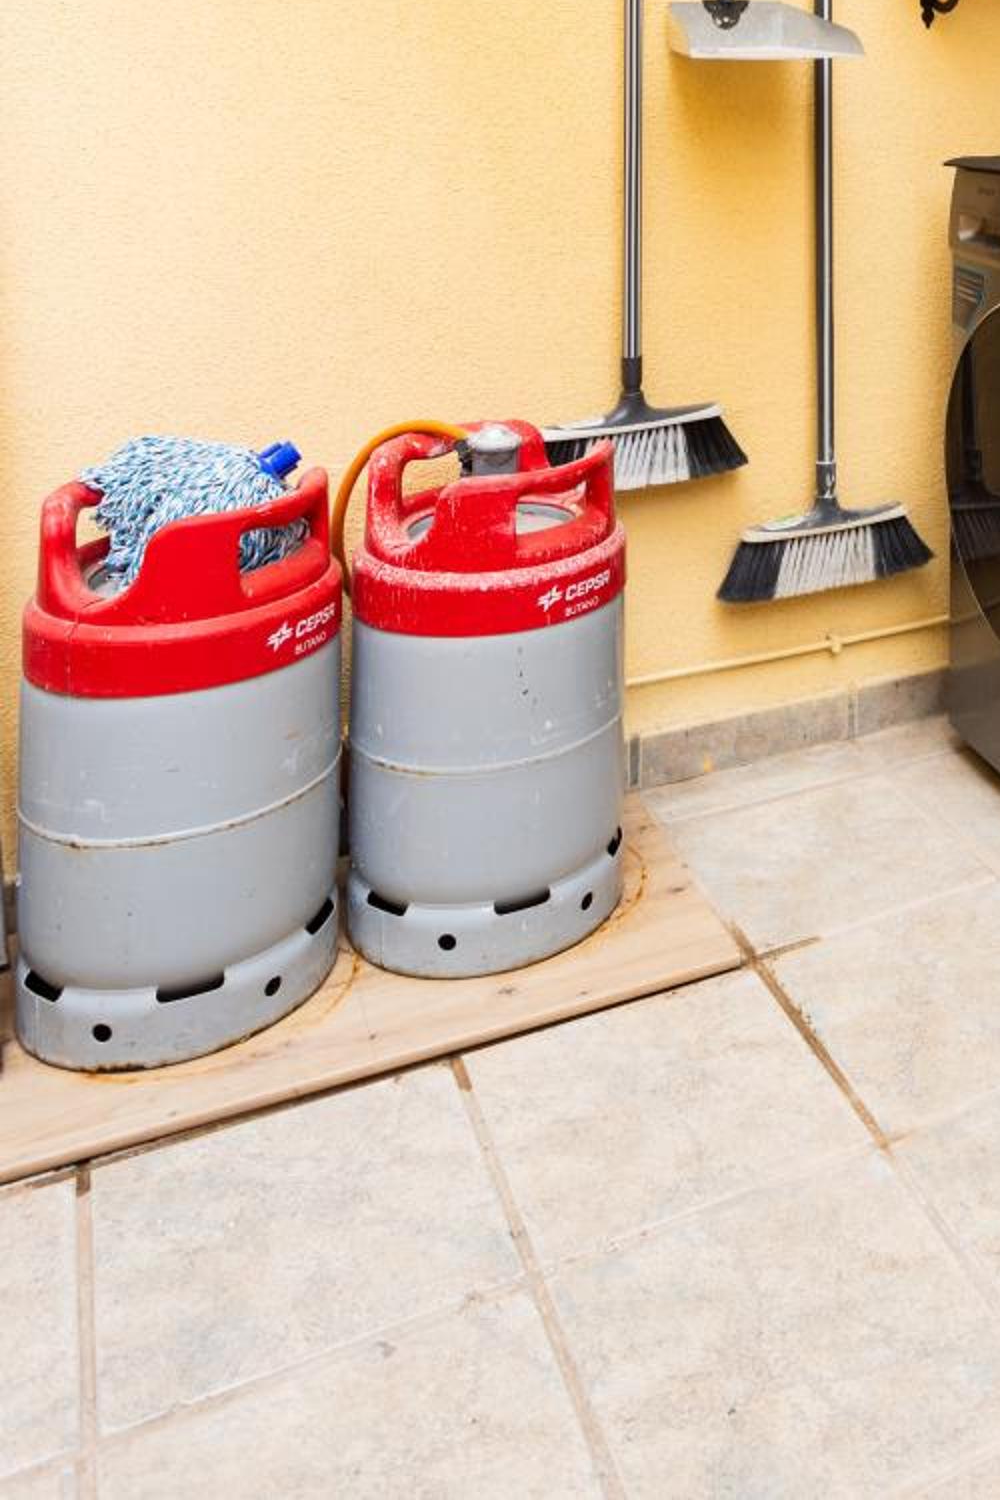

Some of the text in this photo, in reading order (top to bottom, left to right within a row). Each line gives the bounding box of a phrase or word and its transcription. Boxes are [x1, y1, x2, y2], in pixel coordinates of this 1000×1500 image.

[565, 569, 610, 600] CEPSA
[565, 596, 598, 616] BUTANO
[295, 602, 335, 638] CEPSA
[294, 631, 326, 655] BUTANO
